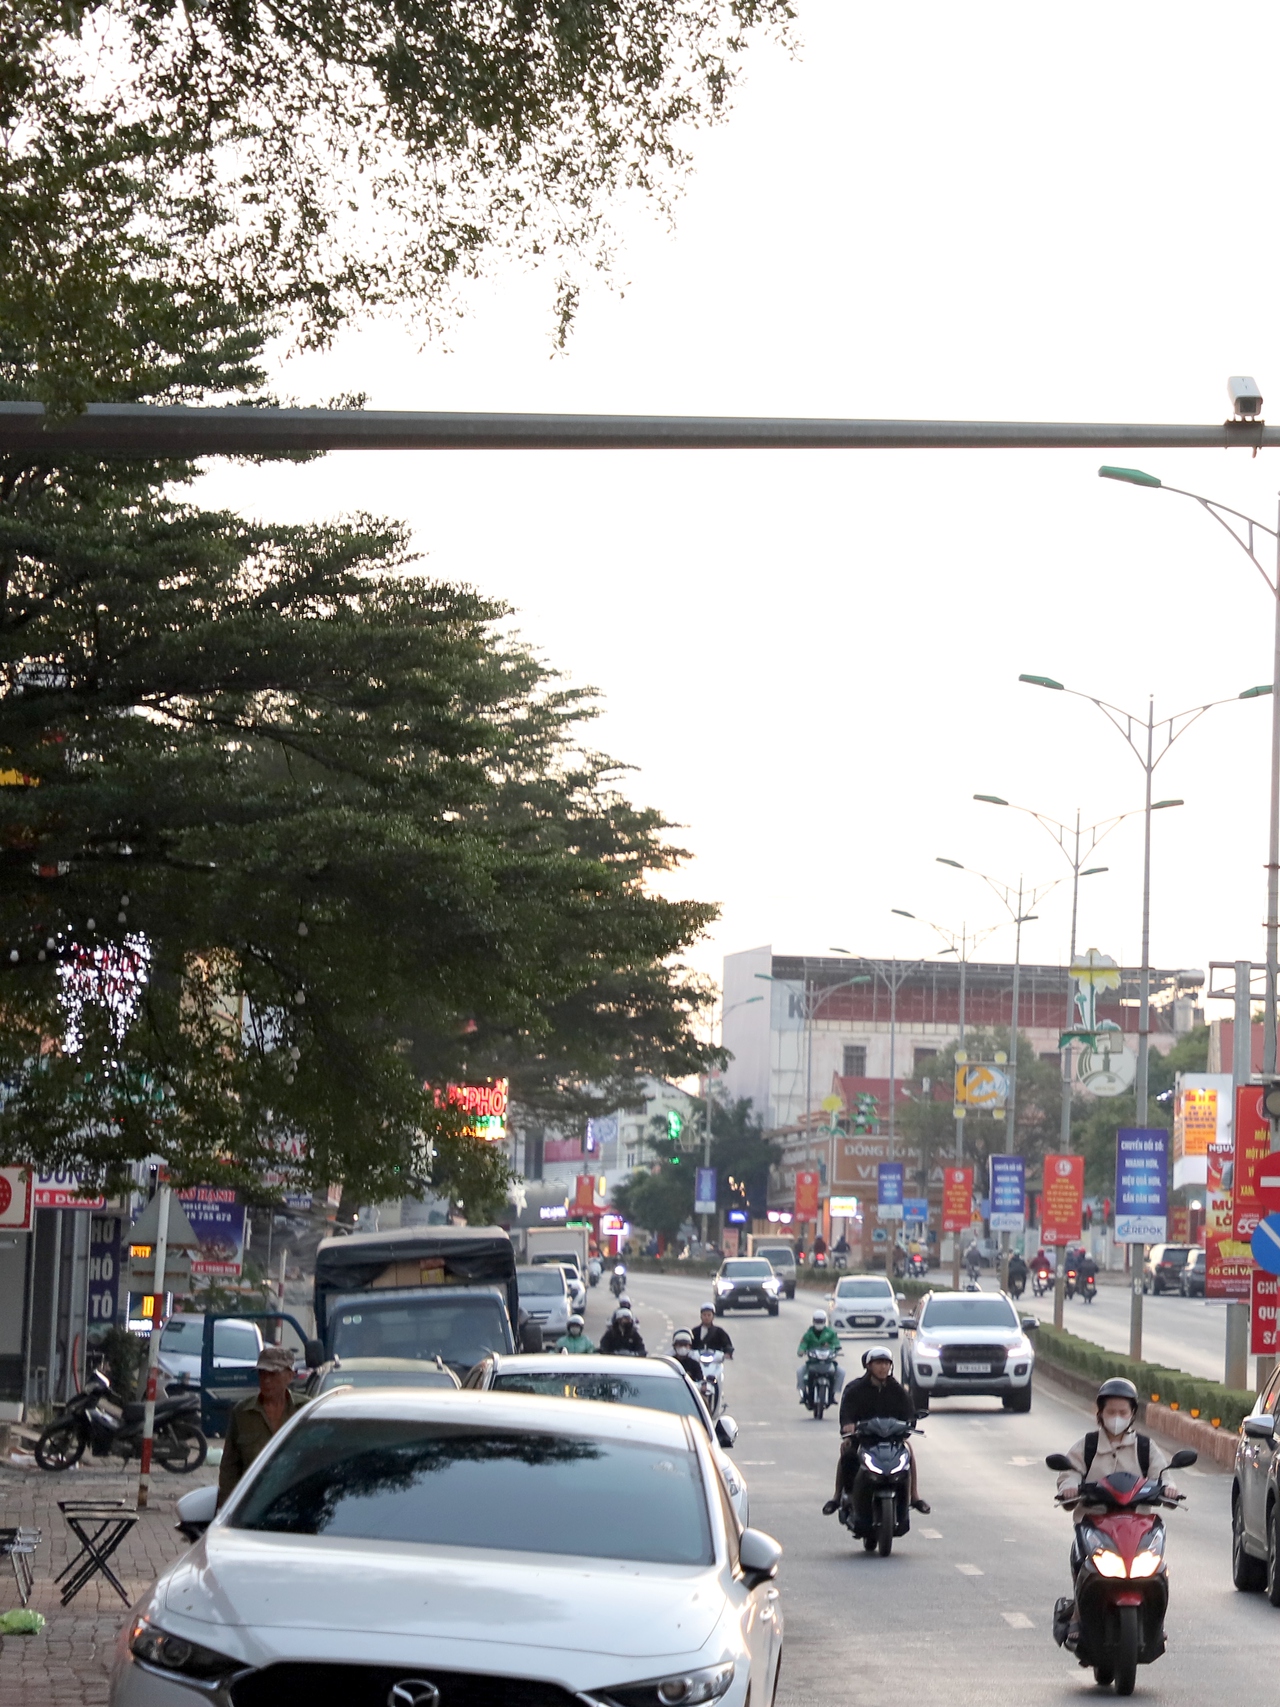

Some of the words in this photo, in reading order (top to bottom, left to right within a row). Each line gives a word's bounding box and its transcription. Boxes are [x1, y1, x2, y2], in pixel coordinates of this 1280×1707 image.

[1124, 1158, 1145, 1169] NHANH
[35, 1193, 51, 1204] LÊ
[91, 1288, 113, 1319] TÔ
